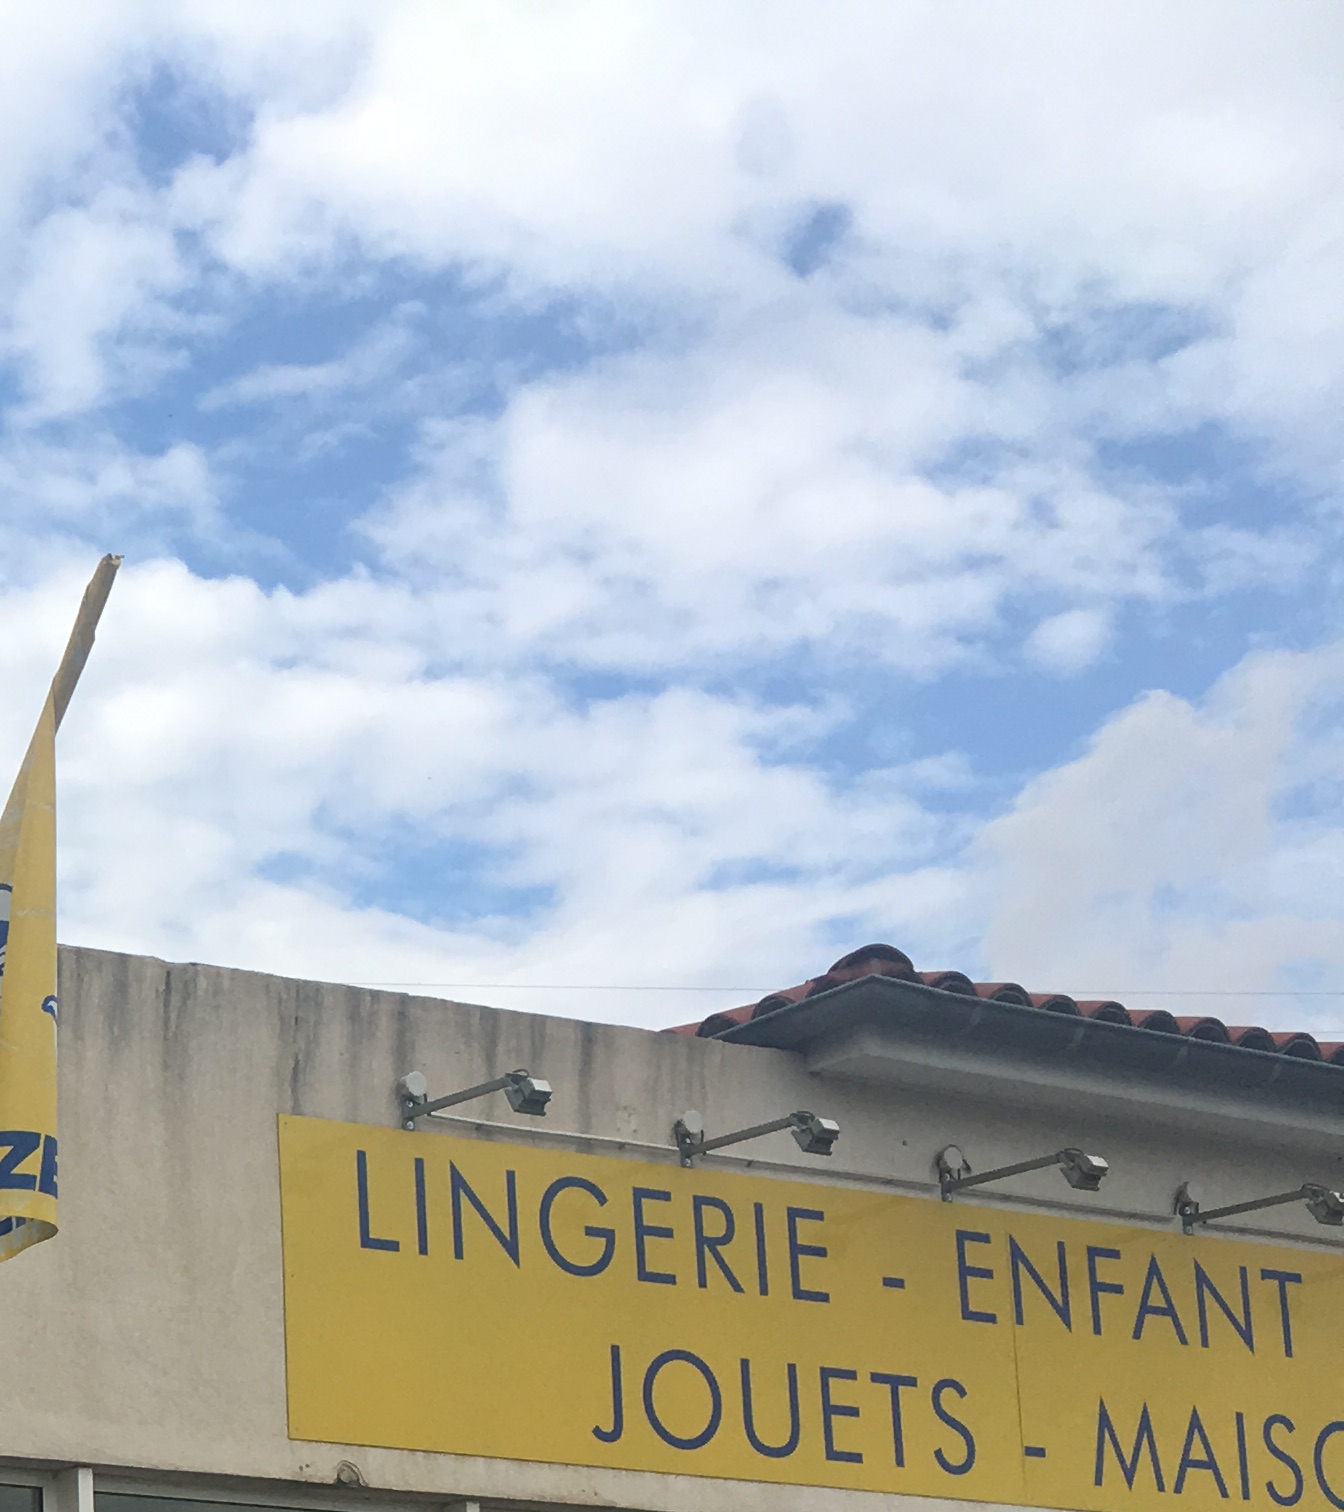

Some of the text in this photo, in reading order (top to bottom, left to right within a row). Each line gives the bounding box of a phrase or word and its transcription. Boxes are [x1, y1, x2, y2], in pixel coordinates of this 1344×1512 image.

[355, 1149, 830, 1304] LINGERIE
[955, 1229, 1302, 1359] ENFANT
[592, 1343, 976, 1476] JOUETS
